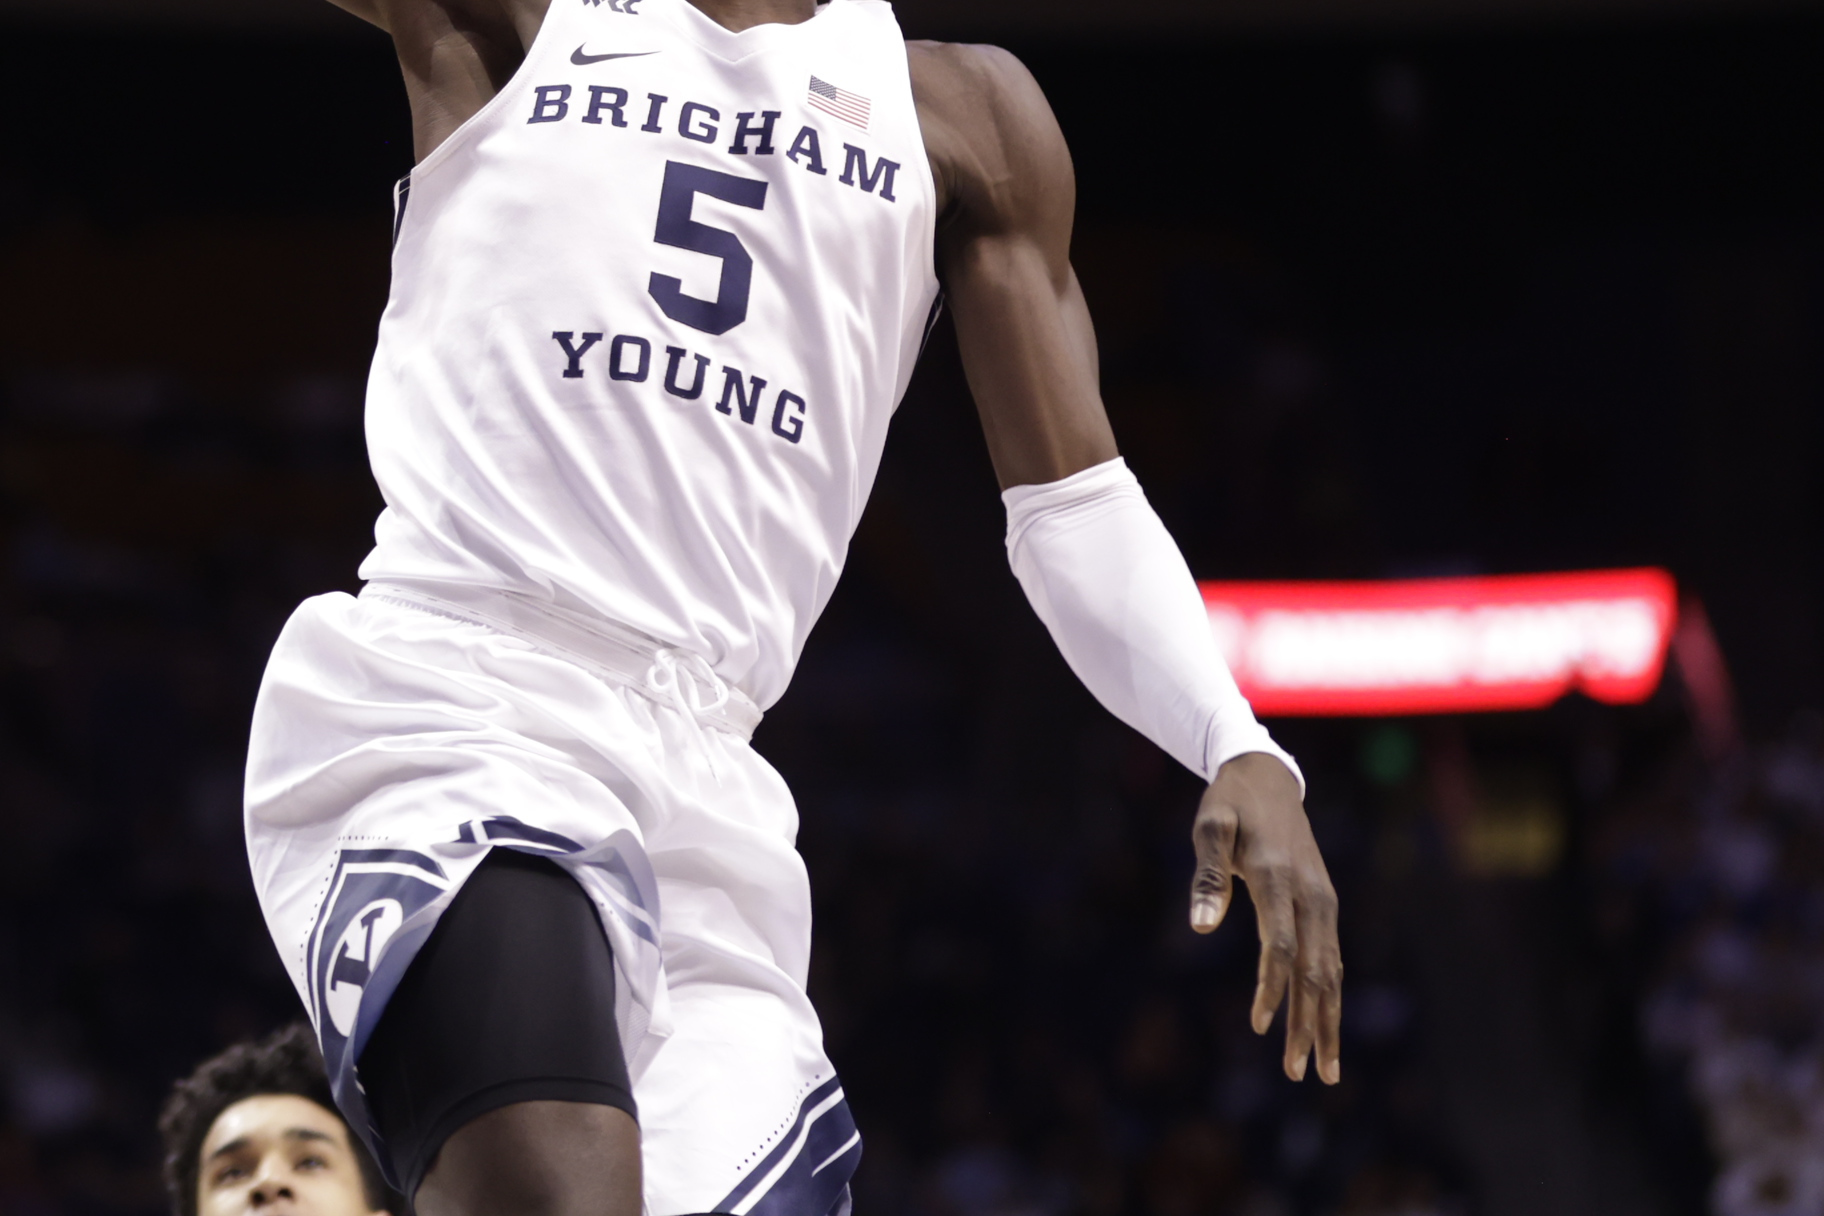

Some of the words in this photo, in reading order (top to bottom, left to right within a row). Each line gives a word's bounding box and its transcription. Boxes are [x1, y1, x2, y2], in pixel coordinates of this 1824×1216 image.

[526, 83, 901, 203] BRIGHAM
[647, 158, 769, 336] 5
[551, 330, 807, 444] YOUNG
